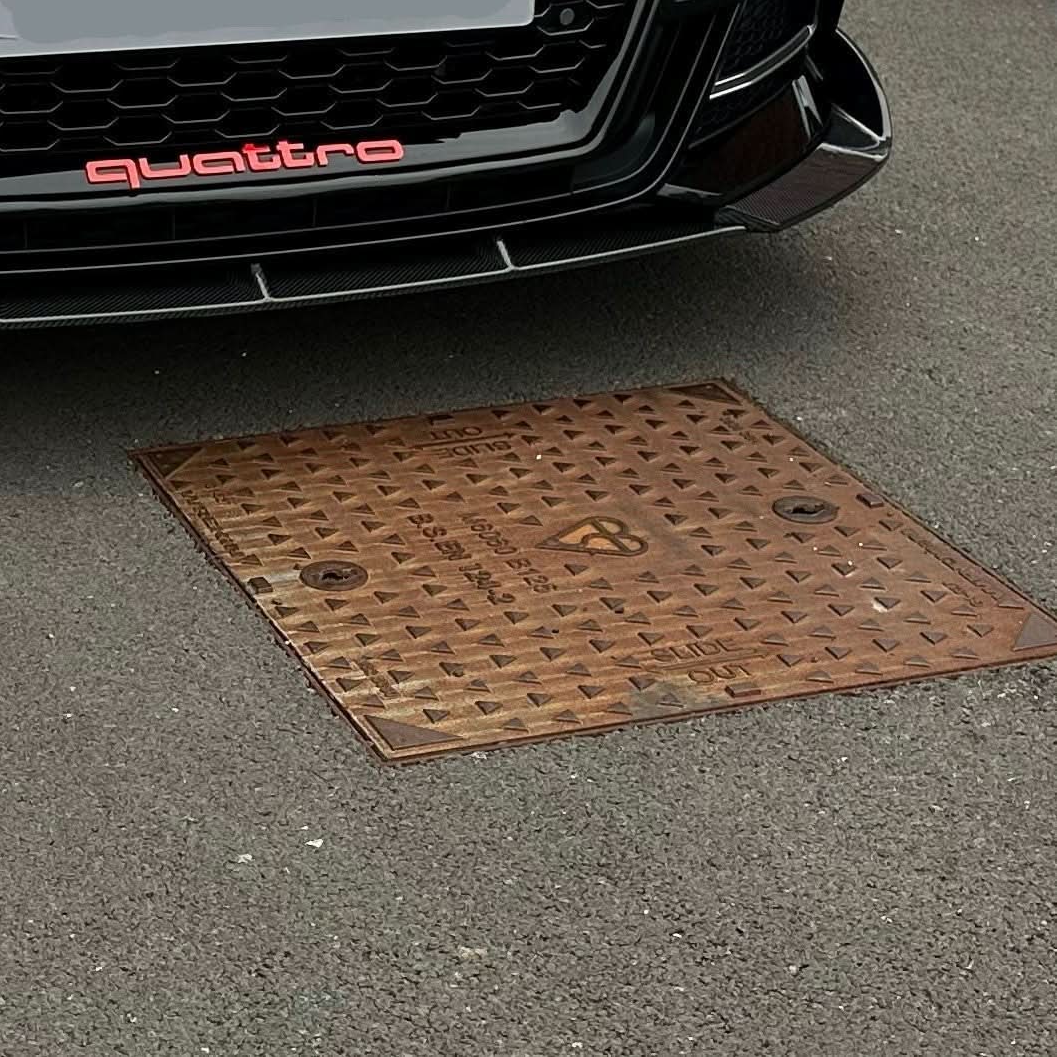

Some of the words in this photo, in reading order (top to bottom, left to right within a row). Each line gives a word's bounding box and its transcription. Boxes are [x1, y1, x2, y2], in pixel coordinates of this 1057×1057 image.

[85, 139, 405, 189] quattro
[429, 426, 483, 440] OUT
[505, 558, 558, 593] B125
[650, 639, 744, 662] SLIDE
[688, 663, 752, 684] OUT
